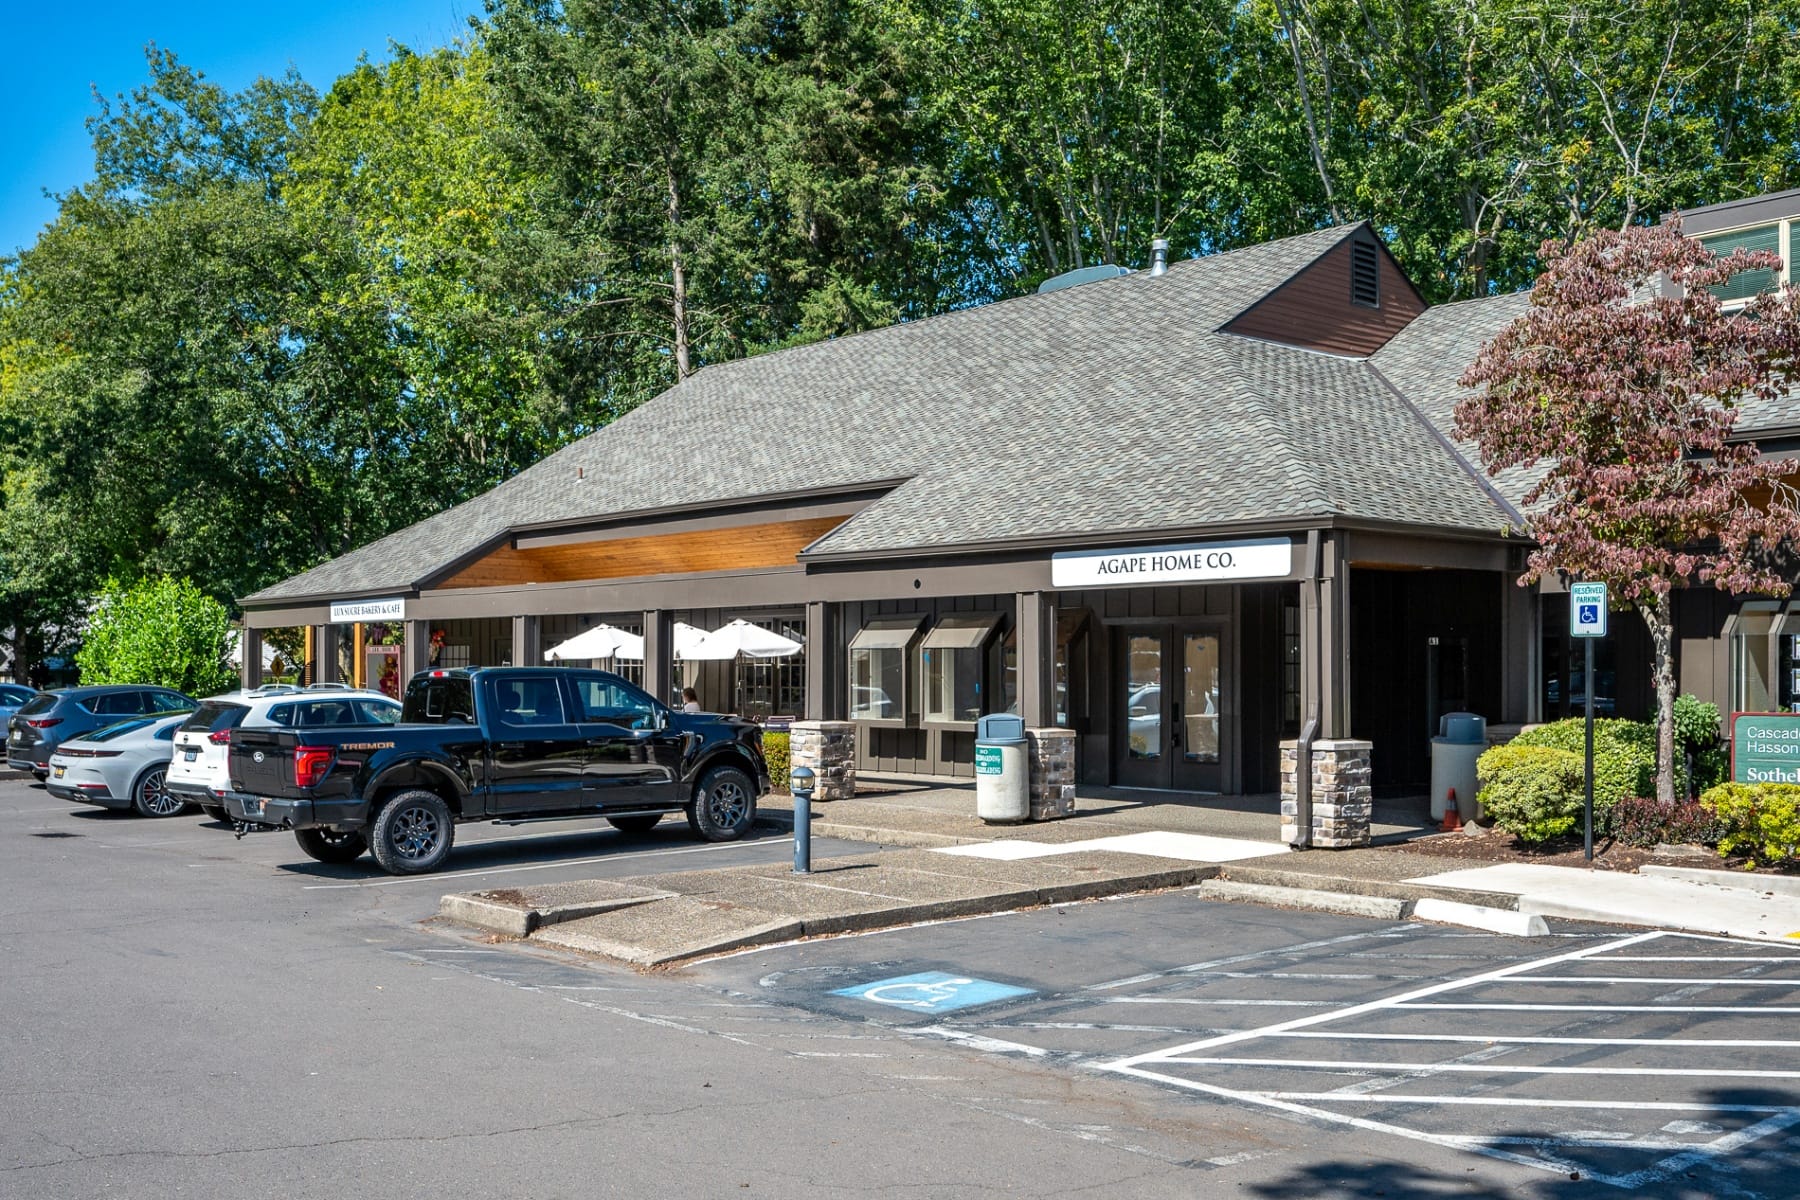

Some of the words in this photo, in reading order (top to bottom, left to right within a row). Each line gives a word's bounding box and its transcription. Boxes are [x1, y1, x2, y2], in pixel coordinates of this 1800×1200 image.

[1097, 557, 1147, 574] AGAPE
[1151, 554, 1202, 571] HOME
[1206, 552, 1236, 568] CO.
[1575, 586, 1603, 594] RESERVED
[361, 604, 381, 615] BAKERY
[1747, 726, 1800, 739] Cascad
[340, 742, 395, 750] TREMOR
[1747, 741, 1799, 754] Hasson
